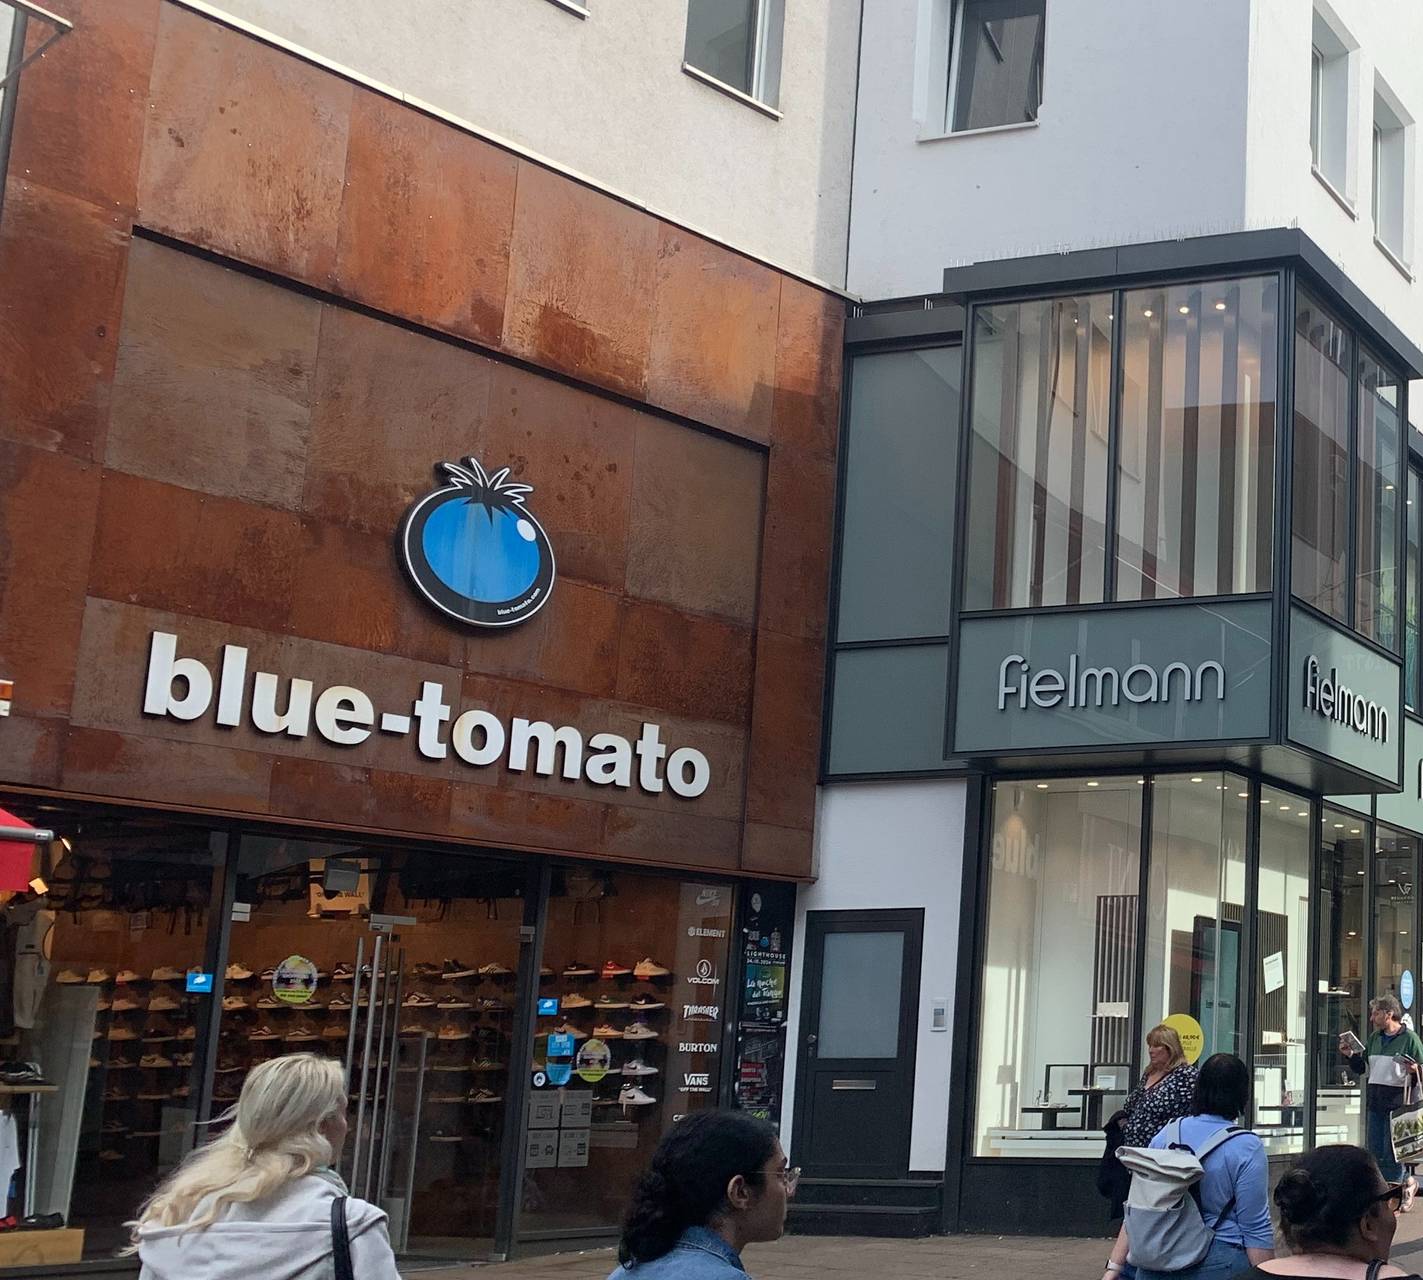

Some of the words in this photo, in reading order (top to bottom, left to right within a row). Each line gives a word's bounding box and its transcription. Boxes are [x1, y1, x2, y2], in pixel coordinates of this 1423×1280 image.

[999, 653, 1226, 710] fielmann
[1306, 654, 1389, 743] fielmann
[143, 631, 711, 797] blue-tomato
[695, 927, 726, 938] ELEMENT
[687, 977, 720, 985] VOLCOM
[683, 1005, 719, 1019] THRASHER
[679, 1043, 718, 1052] BURTON
[684, 1073, 709, 1086] VANS
